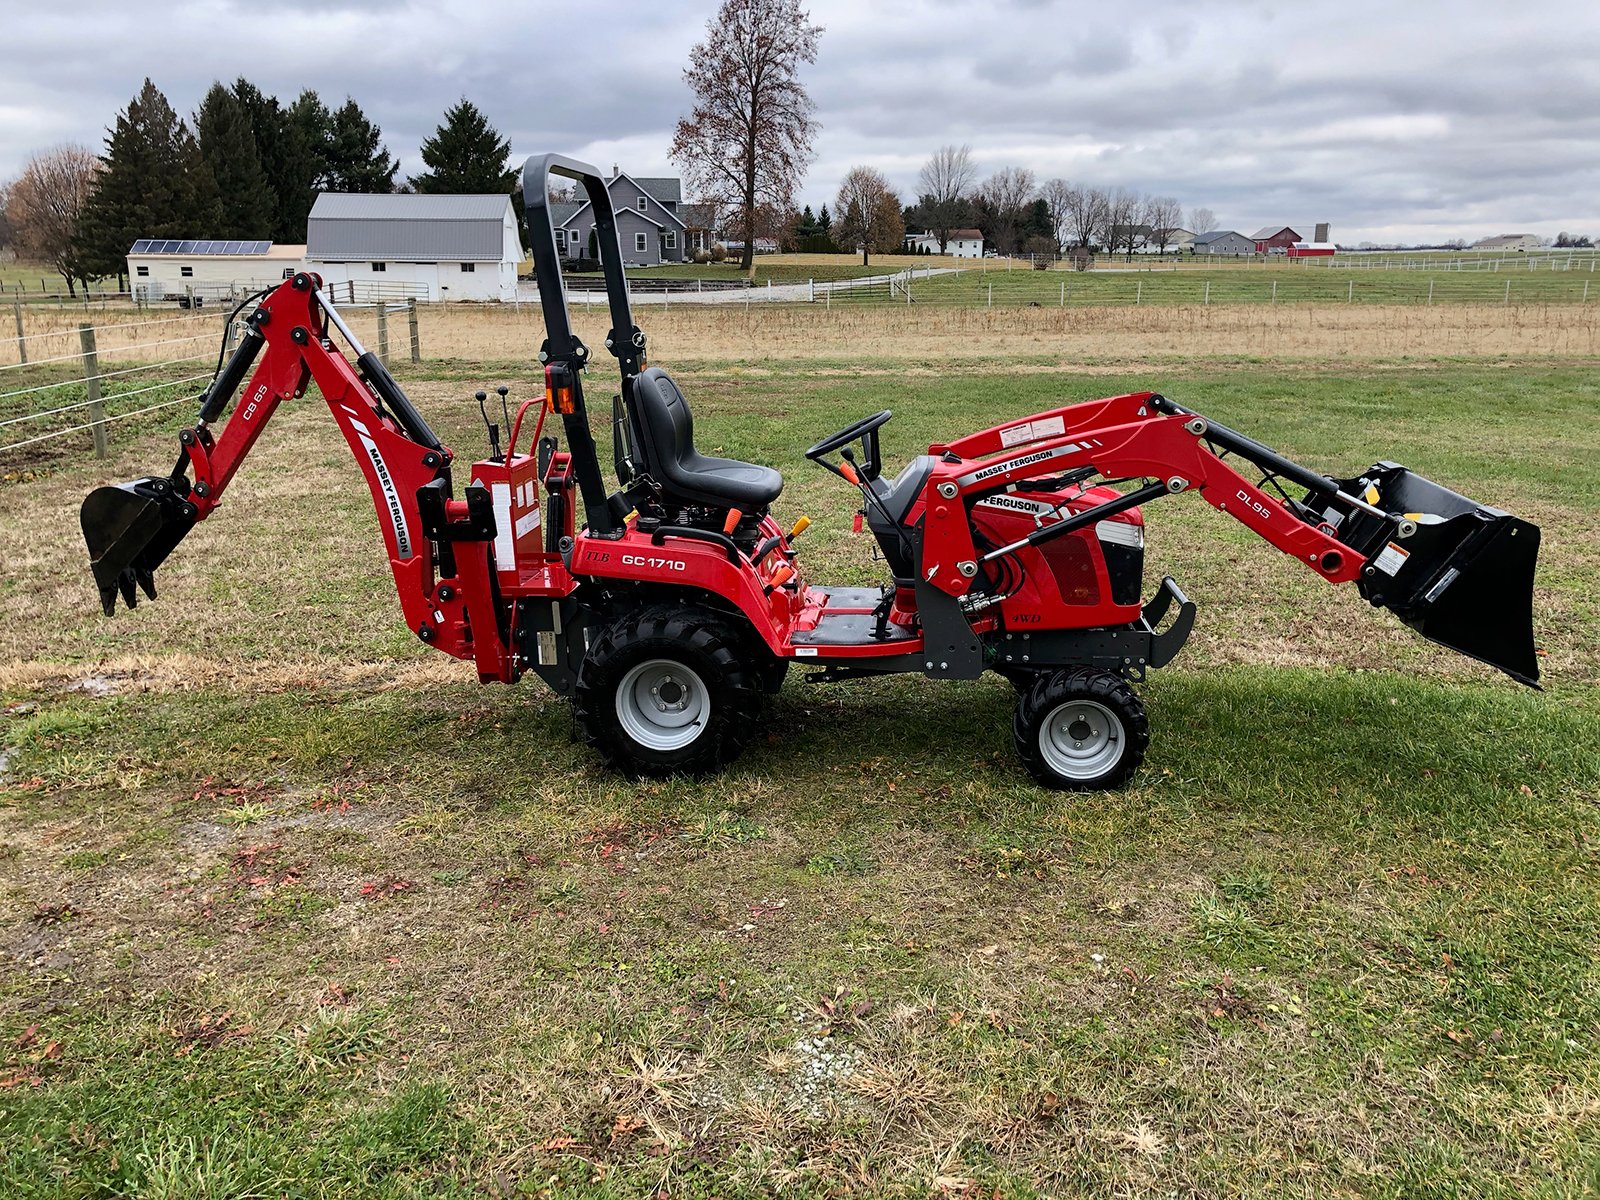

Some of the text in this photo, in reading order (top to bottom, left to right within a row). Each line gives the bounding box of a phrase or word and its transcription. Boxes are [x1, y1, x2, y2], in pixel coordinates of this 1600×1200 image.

[974, 450, 1053, 481] MASSEY FERGUSON
[369, 448, 409, 553] MASSEY FERGUSON
[983, 496, 1040, 513] FERGUSON
[1235, 489, 1272, 519] DL95
[586, 551, 610, 563] TLB
[1012, 614, 1041, 623] 4WD
